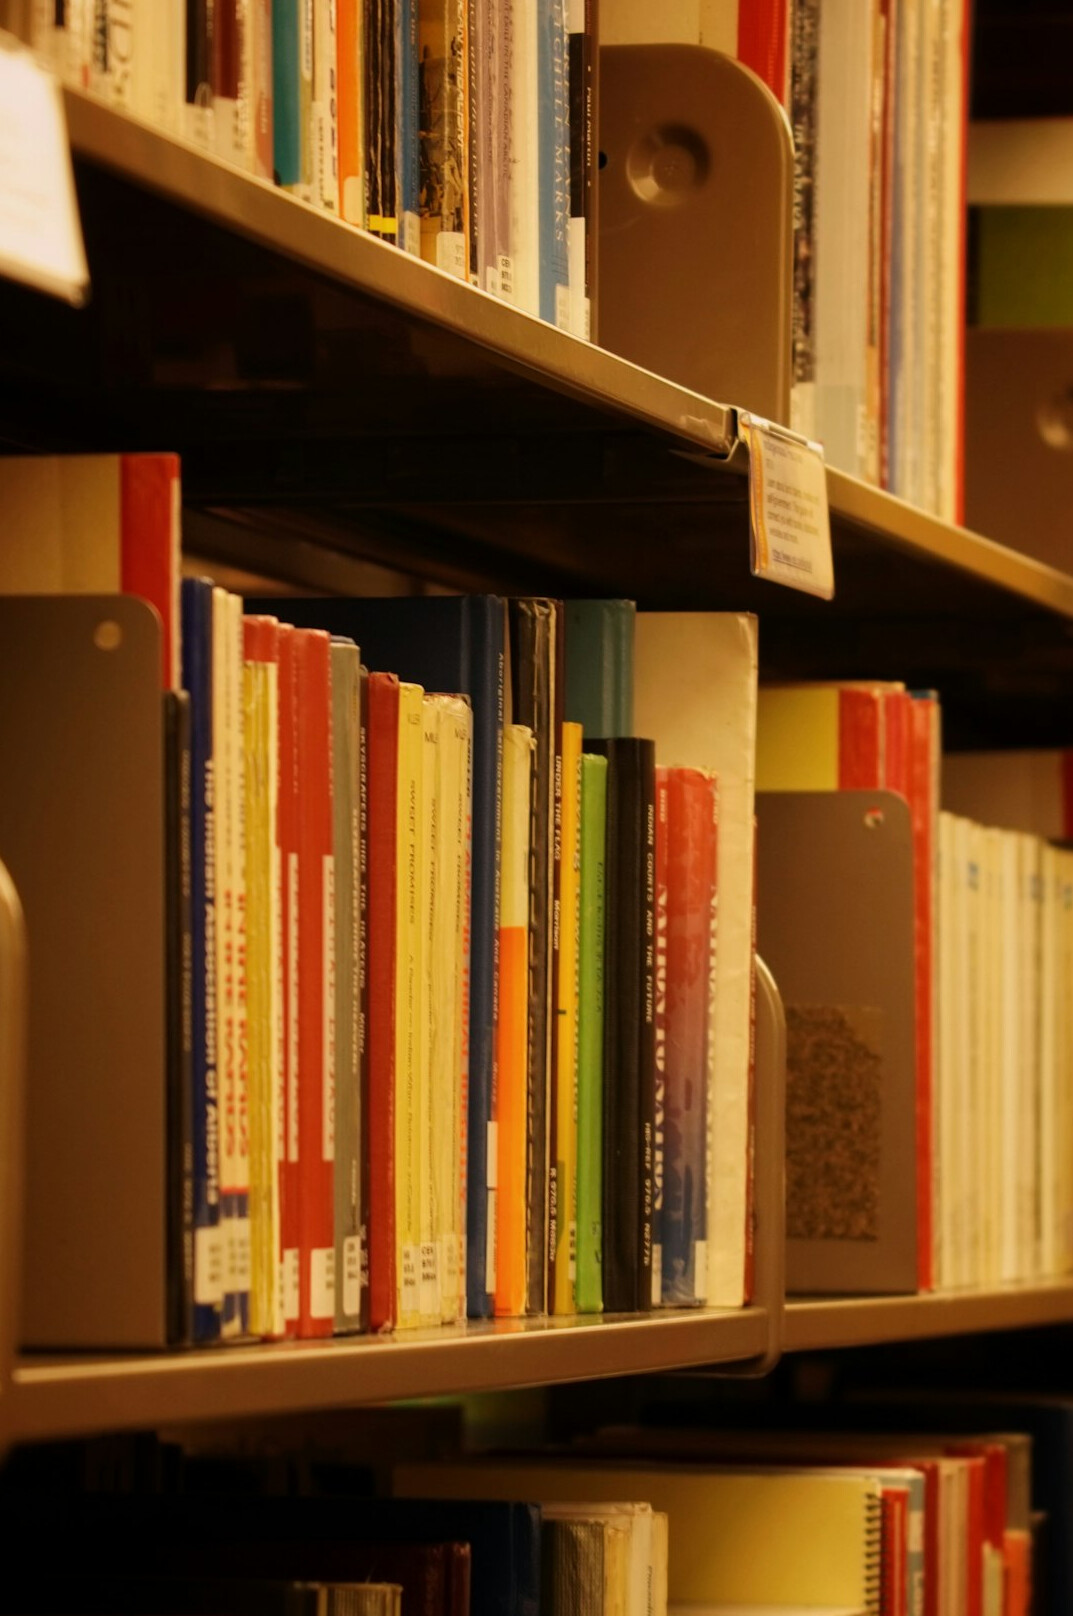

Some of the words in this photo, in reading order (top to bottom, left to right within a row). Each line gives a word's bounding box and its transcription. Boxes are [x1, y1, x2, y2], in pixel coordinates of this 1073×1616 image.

[555, 145, 563, 242] MARKS
[204, 759, 215, 808] The
[646, 804, 654, 846] INDIAN
[205, 811, 215, 899] Indian
[646, 852, 654, 902] COURTS
[656, 883, 667, 1013] NATION
[655, 1028, 666, 1072] TO
[207, 1104, 218, 1205] Alberta
[655, 1079, 664, 1210] NATION
